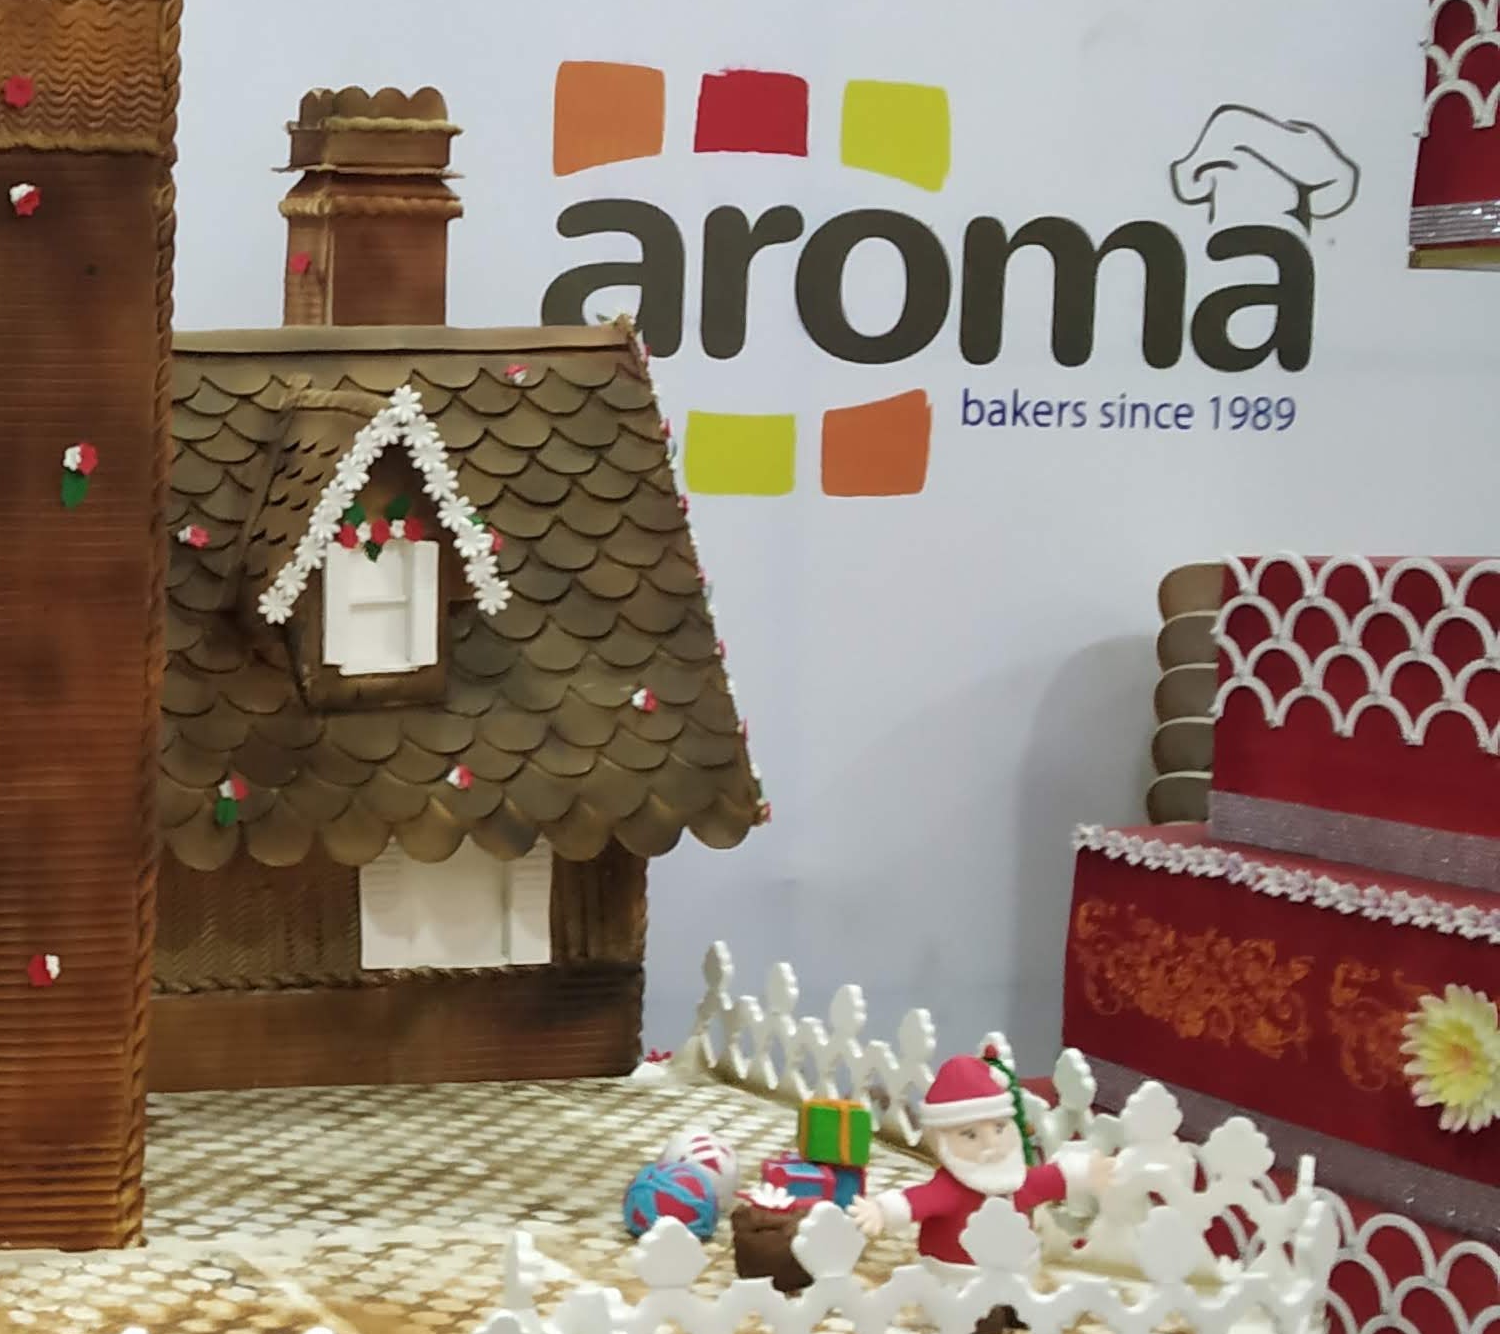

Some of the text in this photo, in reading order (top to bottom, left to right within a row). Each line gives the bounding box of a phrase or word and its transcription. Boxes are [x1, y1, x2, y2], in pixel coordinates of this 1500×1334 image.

[541, 197, 1316, 373] aroma
[961, 387, 1297, 431] bakers since 1989
